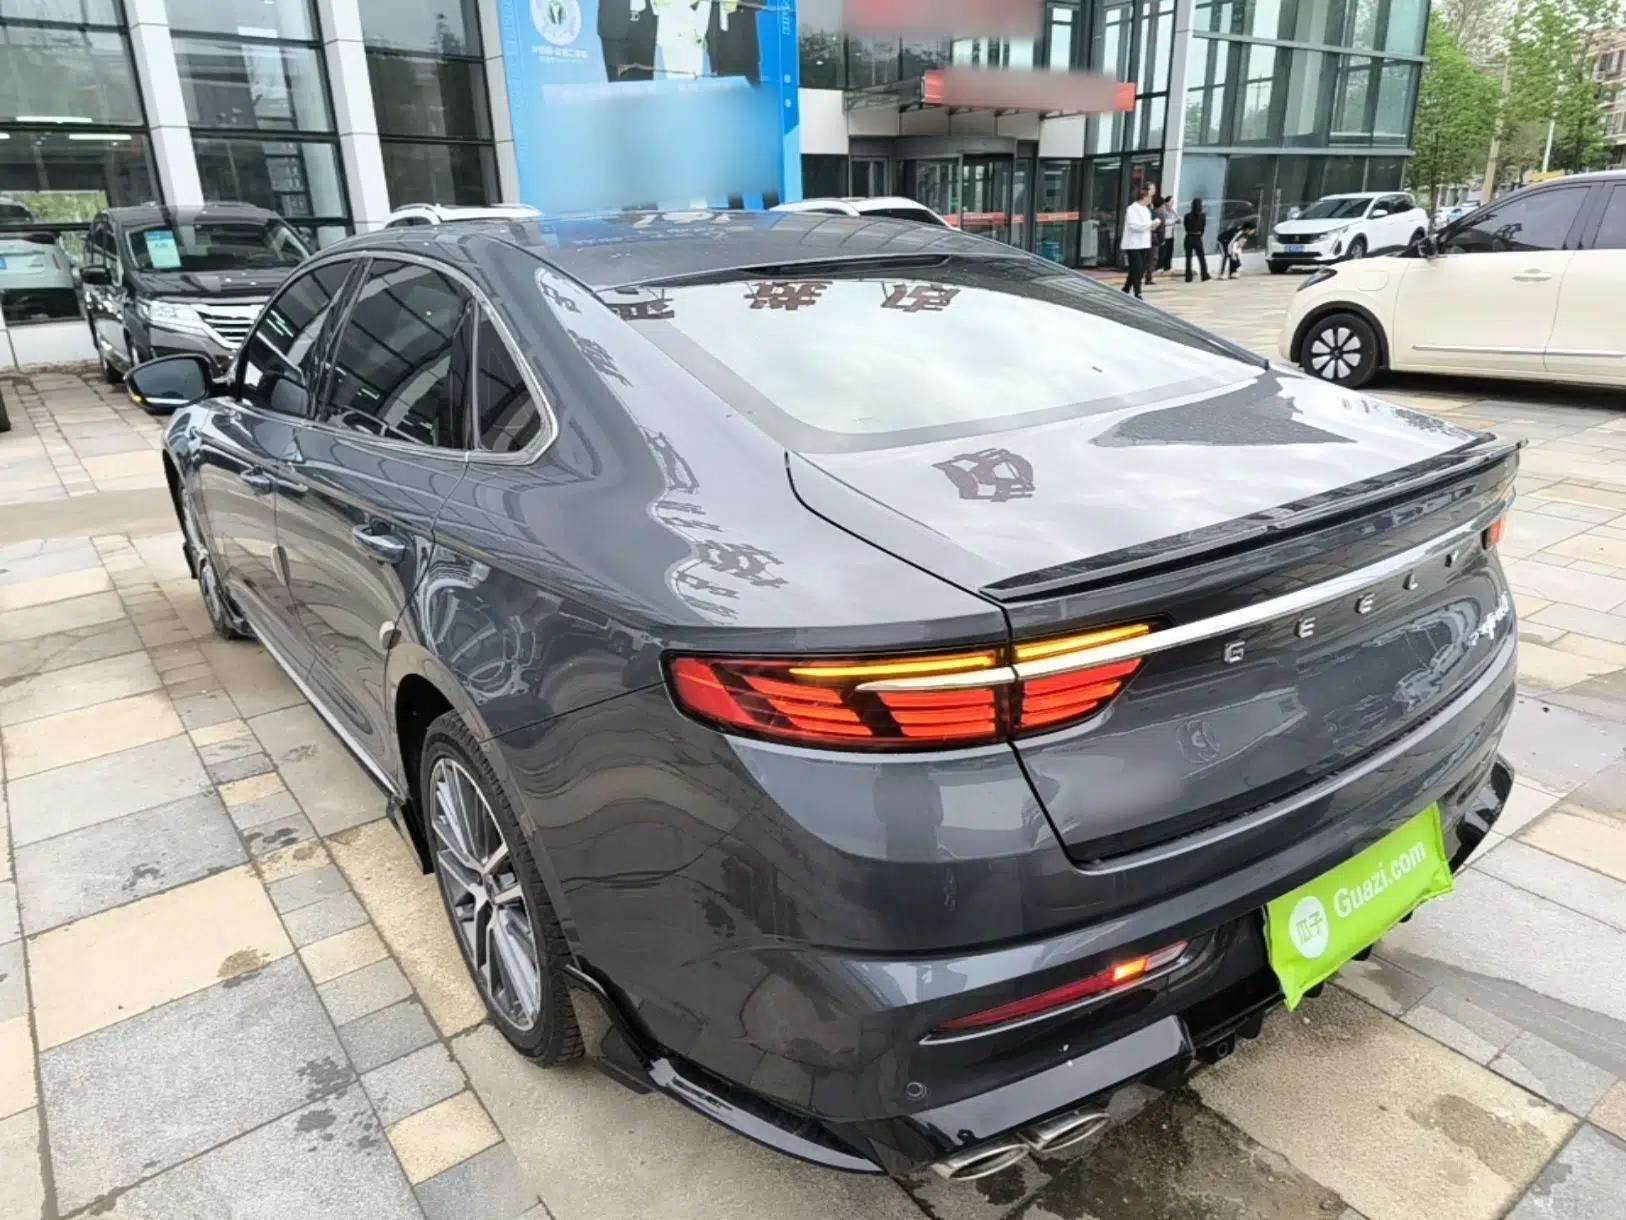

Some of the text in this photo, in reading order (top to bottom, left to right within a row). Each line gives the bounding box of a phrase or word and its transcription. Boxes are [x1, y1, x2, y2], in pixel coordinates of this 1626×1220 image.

[1223, 549, 1460, 664] GEELY
[1333, 841, 1427, 918] Guazi.com
[1295, 911, 1323, 945] 瓜子
